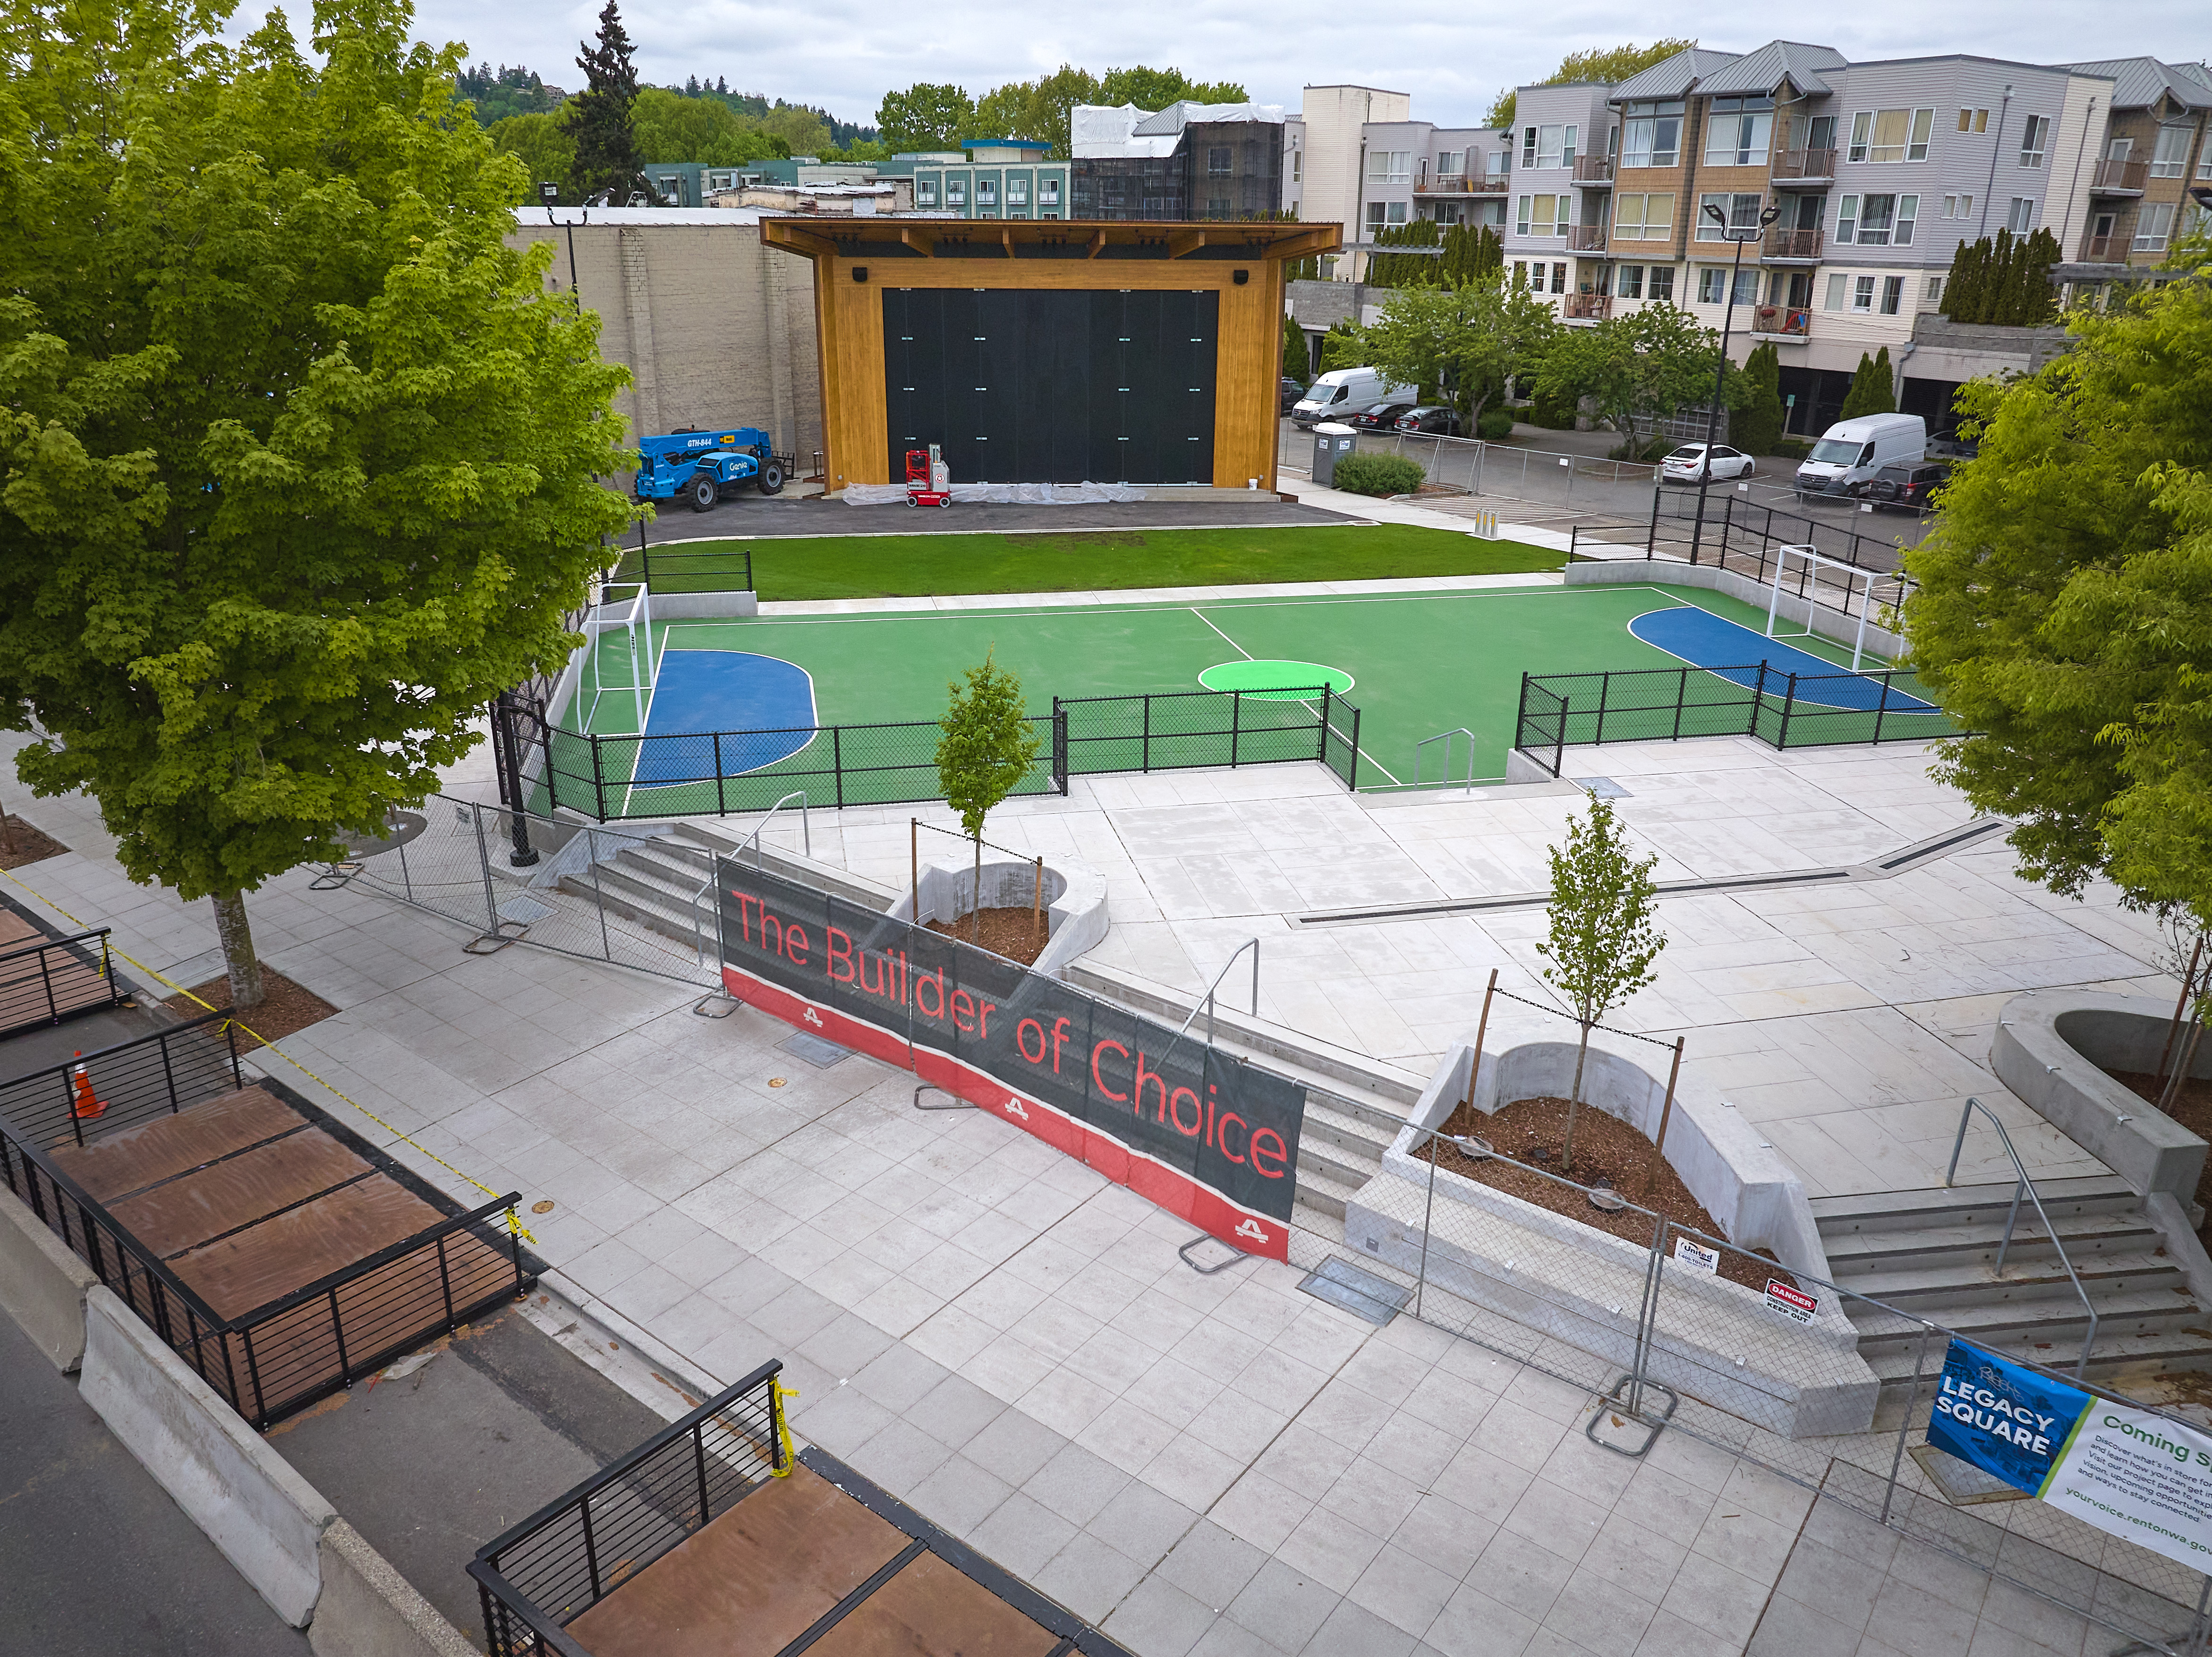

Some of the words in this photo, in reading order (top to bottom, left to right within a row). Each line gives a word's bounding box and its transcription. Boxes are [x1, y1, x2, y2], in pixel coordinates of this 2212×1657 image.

[688, 438, 712, 447] GTH-844
[730, 460, 748, 471] Genie
[732, 890, 809, 965] The
[826, 926, 995, 1039] Builder
[1017, 1016, 1070, 1074] of
[1092, 1040, 1288, 1179] Choice
[1678, 1253, 1713, 1269] 1-800-TOILETS
[1684, 1246, 1712, 1260] United
[1767, 1296, 1799, 1313] CONSTRUCTION
[1799, 1311, 1811, 1319] AREA
[1772, 1285, 1812, 1307] DANGER
[1767, 1302, 1789, 1314] KEEP
[1791, 1313, 1808, 1323] OUT
[1943, 1376, 2055, 1432] LEGACY
[1936, 1397, 2050, 1455] SQUARE
[2103, 1416, 2190, 1462] Coming
[2090, 1443, 2106, 1454] and
[2107, 1450, 2128, 1464] learn
[2129, 1461, 2149, 1473] how
[2150, 1470, 2168, 1480] you
[2169, 1477, 2186, 1487] can
[2188, 1486, 2204, 1496] get
[2095, 1435, 2132, 1455] Discover
[2133, 1453, 2162, 1468] what's
[2164, 1463, 2172, 1472] in
[2174, 1470, 2198, 1483] store
[2077, 1468, 2093, 1478] and
[2095, 1475, 2117, 1489] ways
[2118, 1486, 2128, 1494] to
[2129, 1491, 2149, 1503] stay
[2089, 1450, 2106, 1465] Visit
[2108, 1462, 2123, 1471] our
[2123, 1469, 2156, 1486] project
[2157, 1482, 2180, 1495] page
[2183, 1492, 2192, 1500] to
[2110, 1472, 2154, 1495] upcoming
